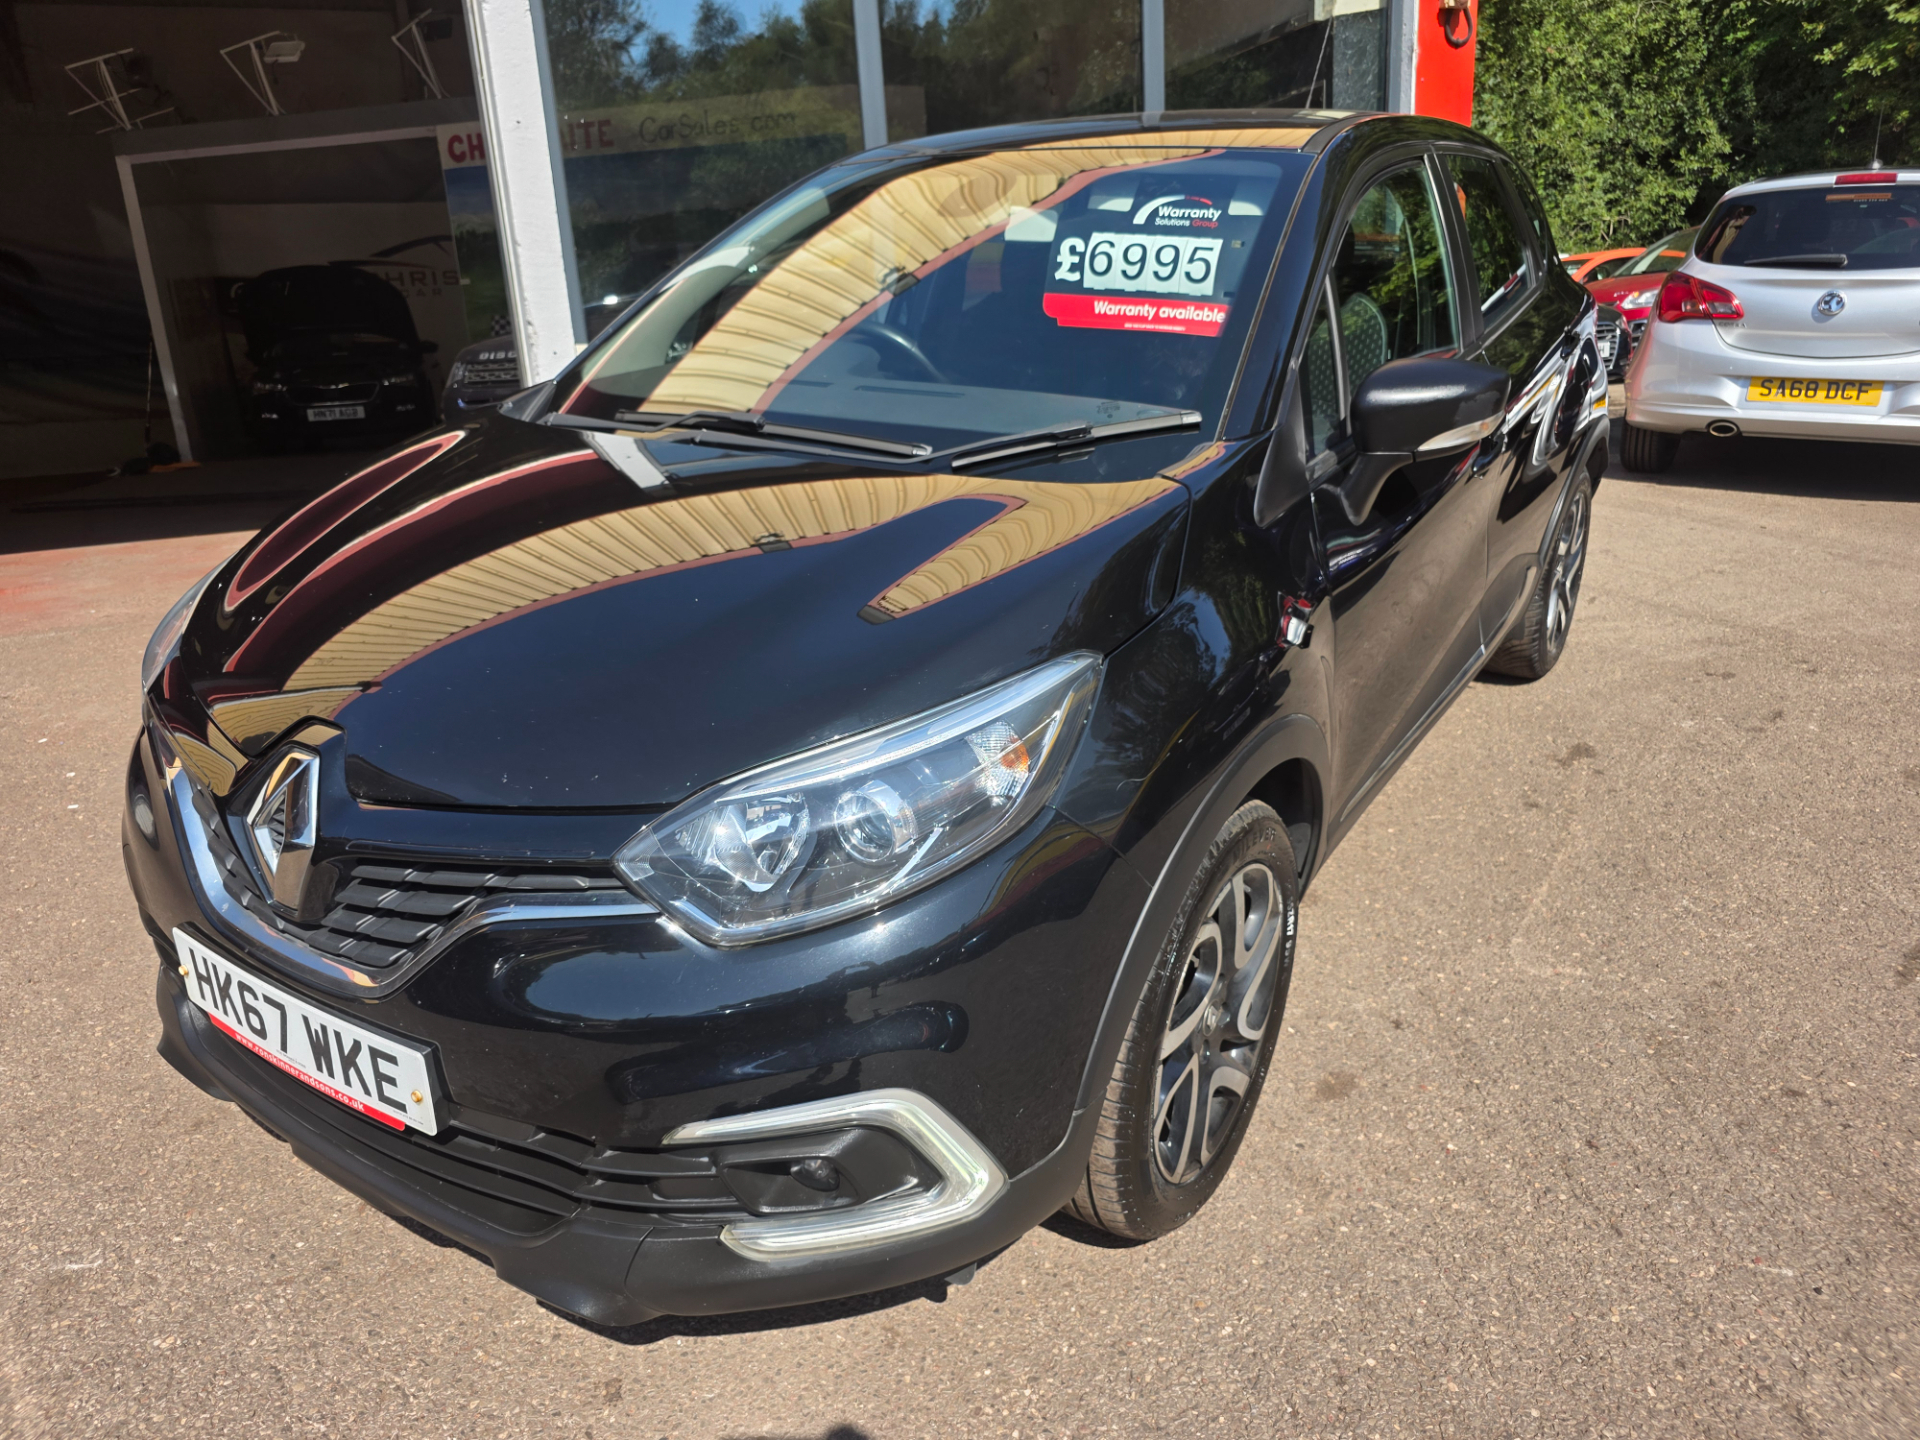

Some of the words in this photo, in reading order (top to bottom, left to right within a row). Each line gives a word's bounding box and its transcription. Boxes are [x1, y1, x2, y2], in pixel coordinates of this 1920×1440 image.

[447, 132, 486, 163] CH
[1154, 217, 1190, 227] Solutions
[1192, 219, 1219, 229] Group
[1158, 205, 1222, 222] Warranty
[1054, 237, 1215, 285] £6995
[385, 270, 460, 287] HRIS
[1094, 300, 1157, 320] Warranty
[1159, 305, 1226, 323] available
[478, 350, 517, 360] DISC
[1759, 378, 1819, 399] SA68
[1824, 380, 1873, 401] DCF
[188, 946, 288, 1054] HK67
[301, 1013, 408, 1114] WKE
[234, 1032, 365, 1112] www.ronskinnerandsons.co.uk
